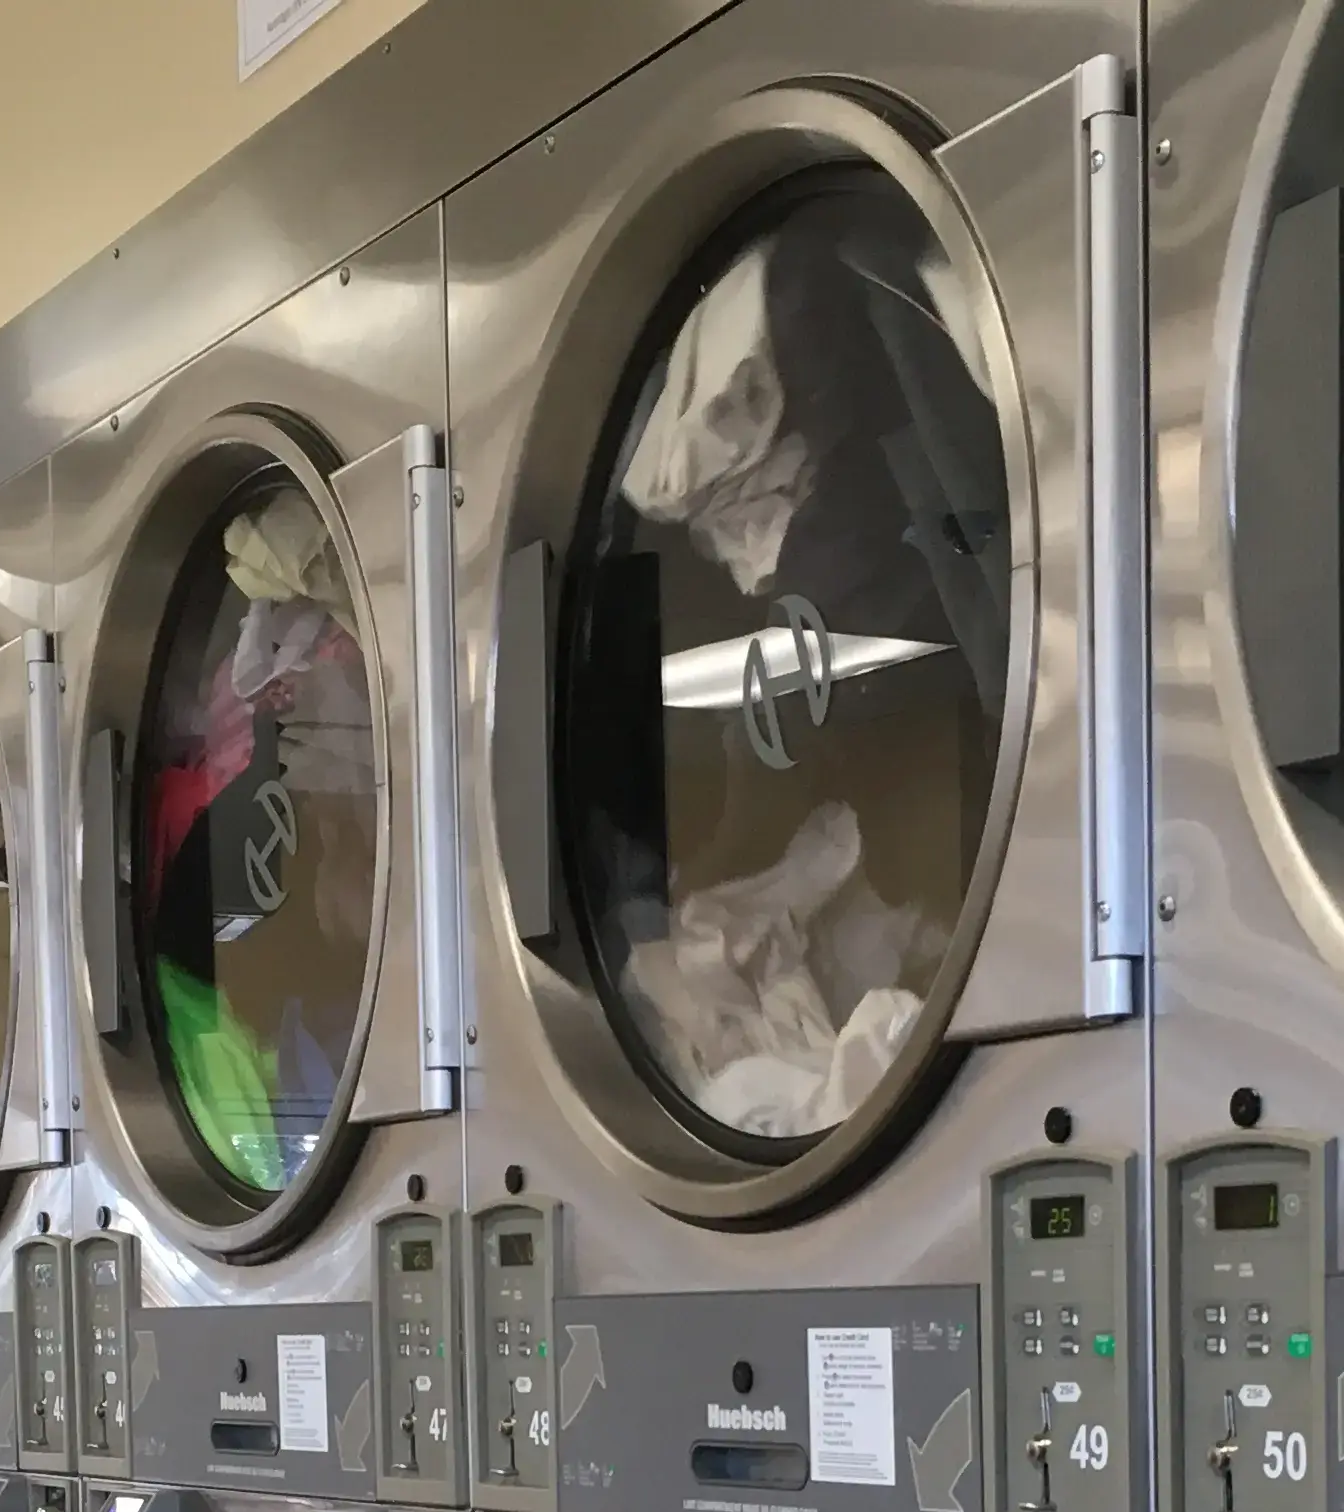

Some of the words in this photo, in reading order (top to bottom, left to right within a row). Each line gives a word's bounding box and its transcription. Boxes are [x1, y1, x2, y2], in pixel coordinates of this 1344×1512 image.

[528, 1409, 550, 1447] 48
[707, 1403, 787, 1432] Huebsch
[1069, 1423, 1109, 1471] 49
[1262, 1430, 1307, 1481] 50
